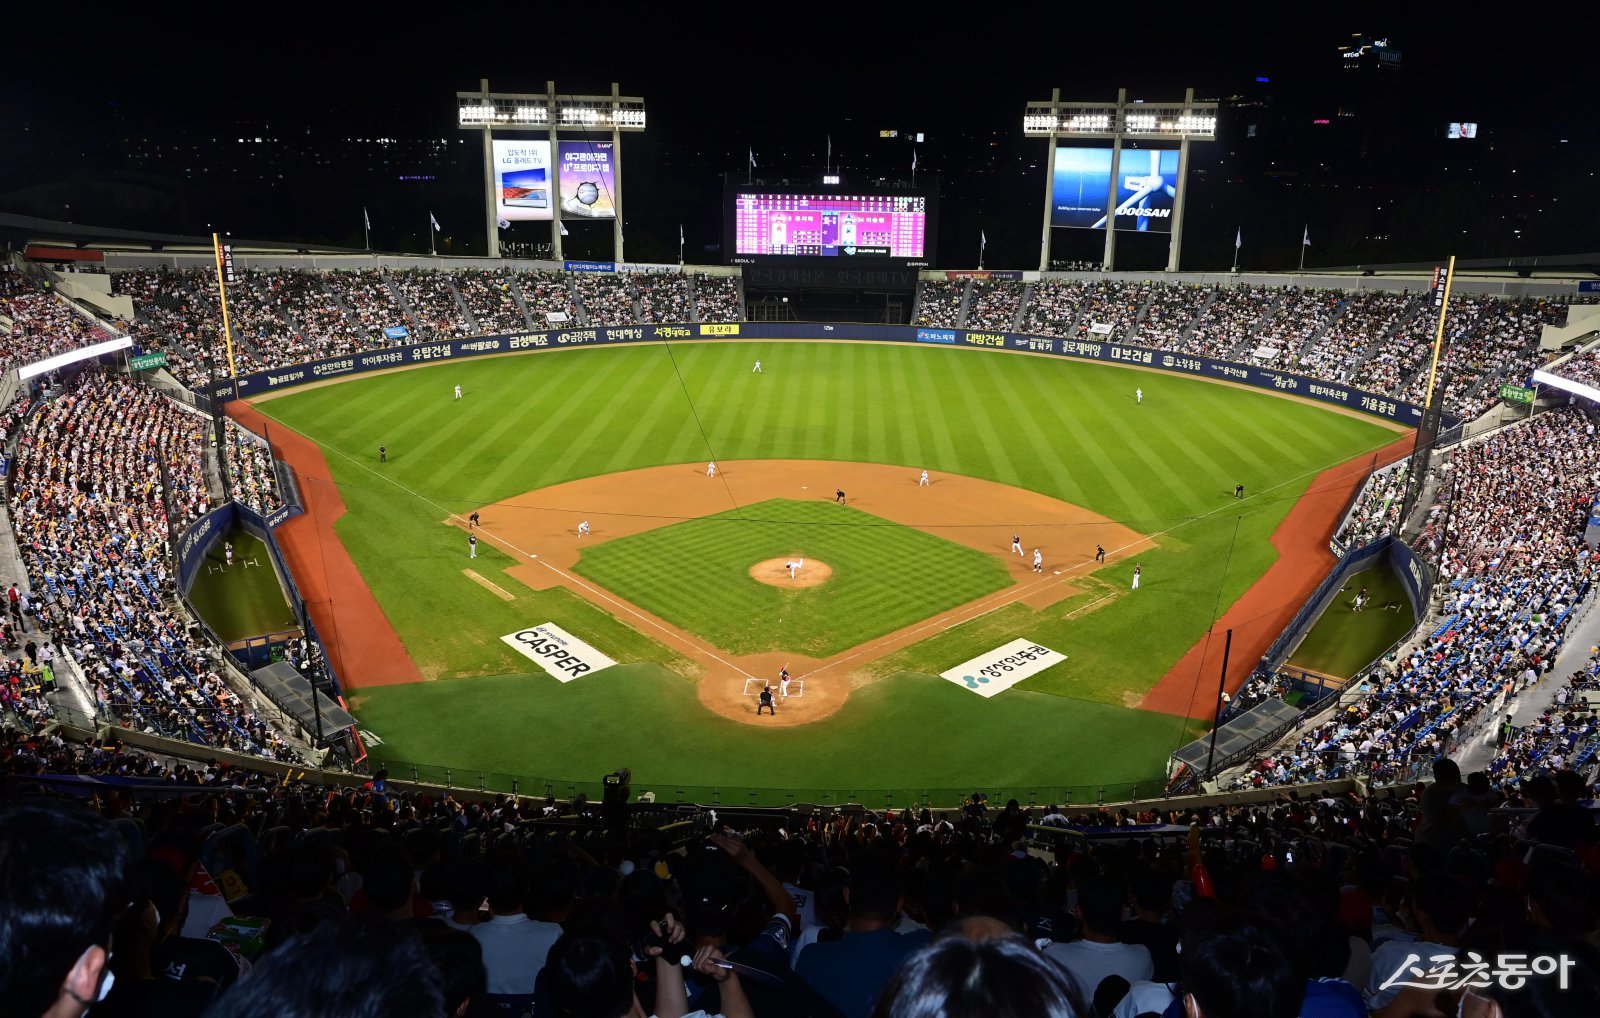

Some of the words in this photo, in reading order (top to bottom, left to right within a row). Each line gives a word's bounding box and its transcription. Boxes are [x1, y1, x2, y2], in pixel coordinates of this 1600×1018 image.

[507, 149, 527, 157] 압도적
[1118, 207, 1171, 218] DOOSAN
[750, 267, 824, 283] 한국경제신문
[838, 270, 911, 285] 한국경제TV
[606, 328, 643, 340] 현대해상
[653, 327, 691, 338] 서경대학교
[708, 325, 732, 334] 유보라
[509, 333, 549, 349] 금성백조
[570, 330, 597, 343] 금강주택
[924, 332, 955, 342] 도미노피자
[965, 333, 1005, 347] 대방건설
[411, 344, 451, 361] 유탑건설
[1029, 341, 1053, 352] 밀워키
[361, 351, 403, 367] 하이투자증권
[1111, 346, 1153, 364] 대보건설
[320, 359, 354, 372] 유안타증권
[1175, 358, 1202, 371] 노랑통닭
[277, 371, 305, 384] 곰표밀가루
[215, 386, 233, 397] 와우넷
[1309, 384, 1349, 401] 웰컴저축은행
[1360, 396, 1397, 417] 키움증권
[514, 630, 591, 678] CASPER
[980, 644, 1050, 678] 상상인증권
